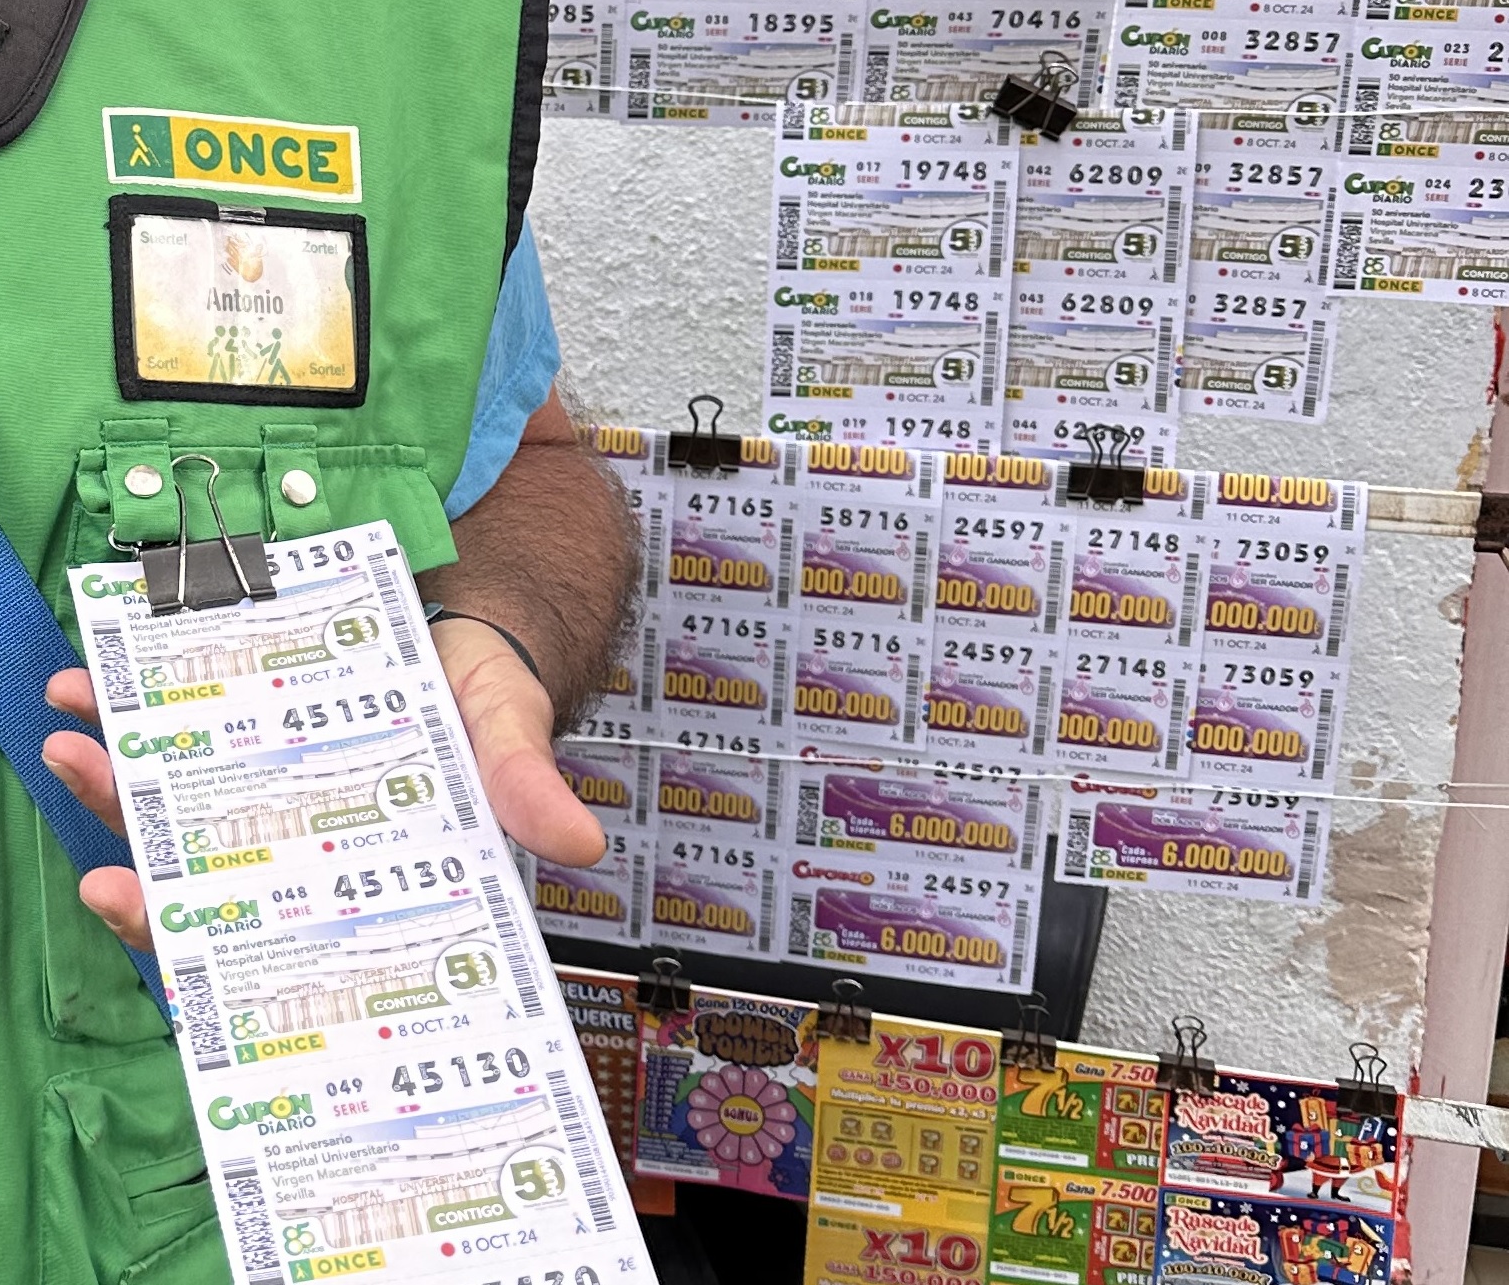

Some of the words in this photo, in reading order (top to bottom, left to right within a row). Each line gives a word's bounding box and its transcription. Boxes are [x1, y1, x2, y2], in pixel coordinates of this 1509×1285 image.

[948, 12, 972, 21] 043
[991, 10, 1081, 29] 70416
[1264, 4, 1271, 14] 8
[1301, 4, 1314, 15] 24
[1412, 8, 1455, 20] ONCE
[705, 14, 729, 25] 038
[748, 13, 834, 32] 18395
[1201, 30, 1227, 42] 008
[1245, 29, 1340, 54] 32857
[1444, 44, 1470, 54] 023
[826, 128, 866, 139] ONCE
[185, 128, 339, 183] ONCE
[856, 161, 881, 172] 017
[901, 160, 987, 182] 19748
[1027, 166, 1052, 176] 042
[1068, 163, 1163, 187] 62809
[1228, 163, 1323, 187] 32857
[1425, 178, 1451, 190] 024
[140, 230, 188, 246] Suerte!
[302, 241, 338, 255] Zorte!
[1379, 280, 1420, 292] ONCE
[206, 287, 284, 315] Antonio
[849, 292, 873, 302] 018
[893, 290, 979, 311] 19748
[1019, 294, 1044, 304] 043
[1061, 293, 1153, 318] 62809
[1213, 294, 1307, 319] 32857
[147, 356, 179, 371] Sort!
[309, 362, 345, 376] Sorte!
[842, 419, 866, 429] 019
[886, 417, 971, 439] 19748
[687, 494, 774, 517] 47165
[820, 506, 908, 531] 58716
[954, 516, 1044, 542] 24597
[1089, 528, 1179, 553] 27148
[1237, 539, 1329, 563] 73059
[265, 540, 354, 577] 5130
[130, 618, 172, 632] Hospital
[175, 610, 241, 626] Universitario
[682, 615, 767, 638] 47165
[813, 629, 901, 653] 58716
[1212, 638, 1222, 649] 11
[1253, 640, 1267, 652] 24
[268, 650, 326, 667] CONTIGO
[943, 640, 1033, 665] 24597
[1076, 654, 1166, 678] 27148
[1224, 664, 1314, 688] 73059
[168, 684, 221, 701] ONCE
[224, 719, 256, 733] 047
[282, 690, 406, 732] 45130
[421, 681, 436, 692] 2€
[230, 736, 261, 748] SERIE
[168, 770, 182, 780] 50
[186, 761, 246, 777] aniversario
[171, 777, 215, 792] Hospital
[219, 767, 287, 783] Universitario
[174, 791, 210, 805] Virgen
[214, 782, 267, 797] Macarena
[176, 803, 212, 815] Sevilla
[317, 810, 379, 828] CONTIGO
[341, 839, 349, 850] 8
[391, 829, 409, 842] 24
[835, 840, 874, 851] ONCE
[212, 848, 268, 869] ONCE
[673, 841, 755, 867] 47165
[272, 886, 307, 903] 048
[334, 857, 465, 901] 45130
[480, 848, 496, 860] 2€
[924, 873, 1011, 899] 24597
[1105, 870, 1146, 881] ONCE
[278, 905, 313, 920] SERIE
[213, 945, 228, 954] 50
[233, 934, 296, 952] aniversario
[216, 953, 264, 968] Hospital
[267, 940, 340, 959] Universitario
[220, 966, 260, 981] Virgen
[263, 958, 319, 975] Macarena
[223, 981, 261, 995] Sevilla
[373, 991, 439, 1012] CONTIGO
[398, 1024, 408, 1037] 8
[452, 1015, 470, 1028] 24
[262, 1034, 322, 1056] ONCE
[325, 1078, 363, 1097] 049
[392, 1047, 530, 1097] 45130
[546, 1039, 564, 1053] 2€
[333, 1101, 370, 1117] SERIE
[264, 1145, 280, 1158] 50
[285, 1134, 353, 1154] aniversario
[268, 1154, 319, 1173] Hospital
[322, 1142, 400, 1164] Universitario
[271, 1170, 314, 1188] Virgen
[317, 1162, 377, 1181] Macarena
[276, 1188, 316, 1203] Sevilla
[434, 1203, 504, 1226] CONTIGO
[461, 1240, 472, 1254] 8
[475, 1234, 518, 1252] OCT.
[518, 1229, 538, 1245] 24
[317, 1250, 381, 1274] ONCE
[618, 1257, 636, 1272] 2€
